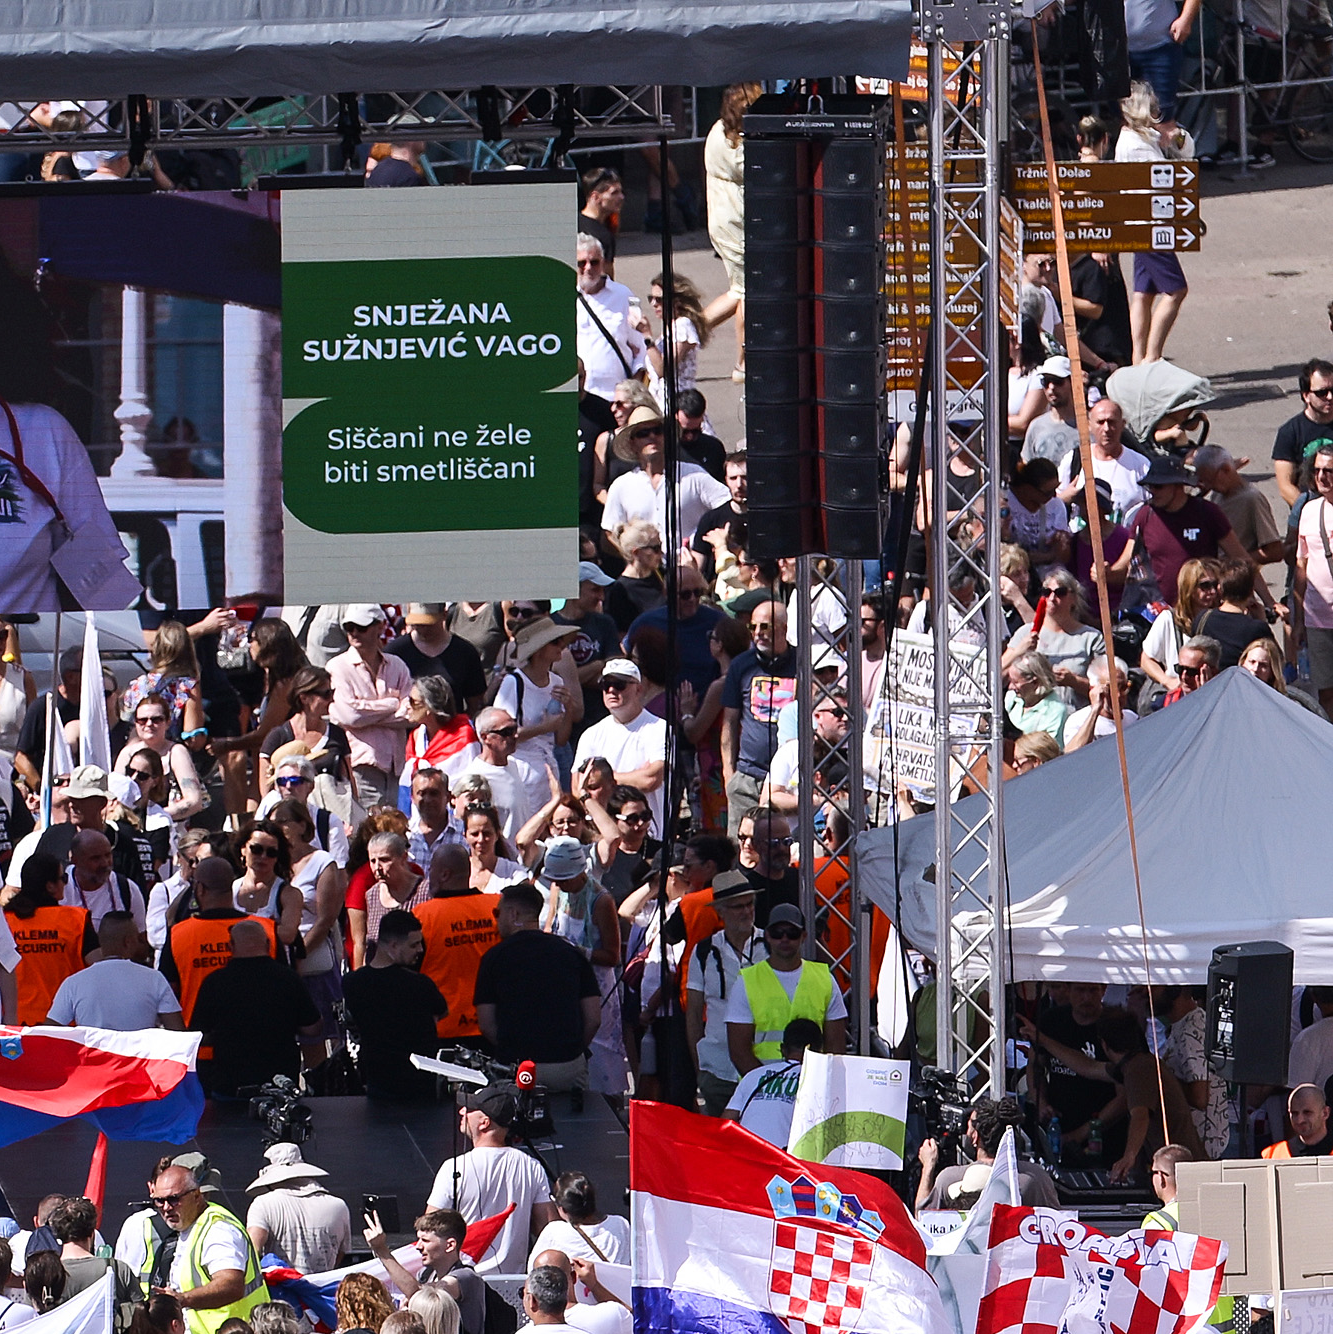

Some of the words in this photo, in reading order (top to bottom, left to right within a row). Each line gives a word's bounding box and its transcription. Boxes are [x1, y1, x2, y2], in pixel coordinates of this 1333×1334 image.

[1015, 167, 1049, 179] Tržnic
[1078, 196, 1104, 210] ulica
[1078, 228, 1112, 241] HAZU
[353, 298, 511, 326] SNJEŽANA
[303, 331, 467, 361] SUŽNJEVIĆ
[475, 334, 562, 357] VAGO
[327, 426, 424, 450] Siščani
[434, 430, 467, 447] ne
[476, 423, 531, 446] žele
[325, 460, 368, 483] biti
[376, 456, 535, 482] smetliščani
[450, 918, 494, 932] KLEMM
[14, 929, 58, 941] KLEMM
[14, 942, 66, 955] ECURITY
[1020, 1215, 1183, 1273] CROATIA
